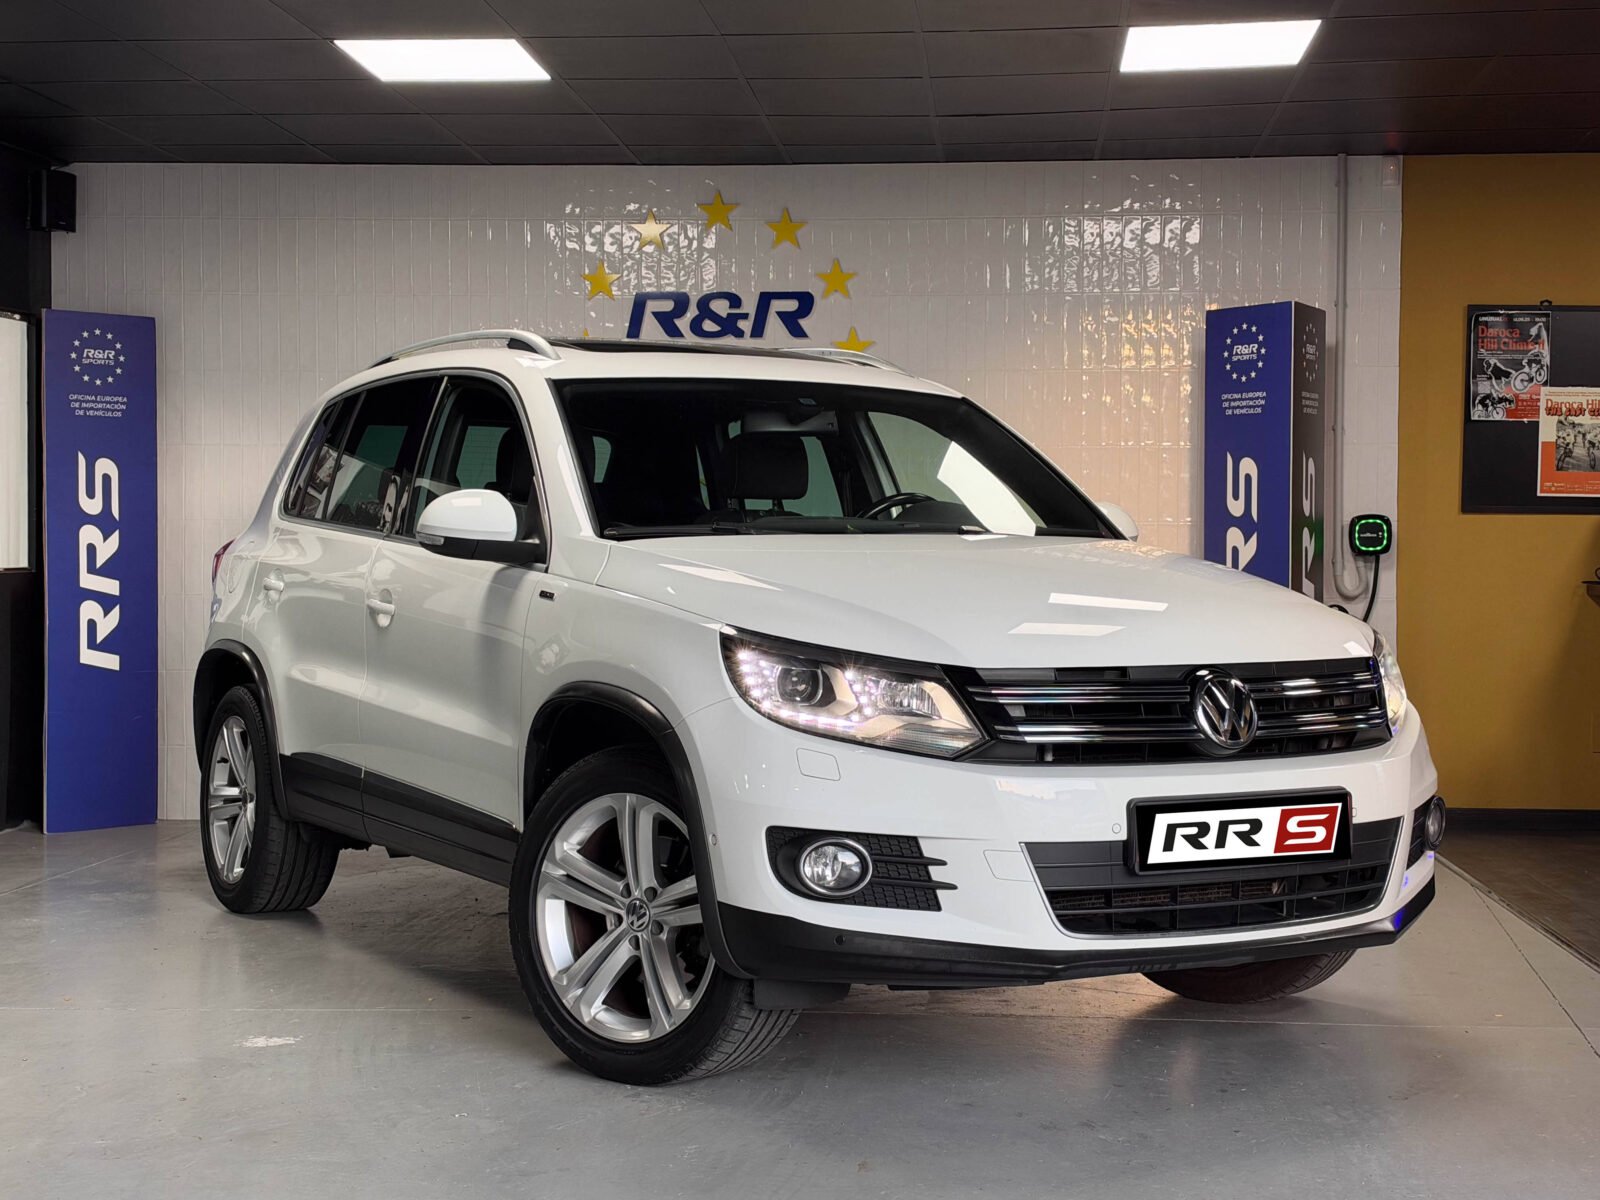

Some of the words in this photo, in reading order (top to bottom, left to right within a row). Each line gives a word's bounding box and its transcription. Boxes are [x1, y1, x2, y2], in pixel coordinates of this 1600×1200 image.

[626, 291, 815, 338] R&R
[1478, 325, 1521, 338] Daroca
[84, 348, 115, 360] R&R
[1233, 344, 1258, 354] R&R
[1242, 391, 1267, 399] EUROPEA
[1230, 399, 1265, 407] IMPORTACIÓN
[1545, 398, 1584, 409] Daroca
[85, 409, 122, 417] VEHÍCULOS
[1233, 407, 1262, 415] VEHÍCULOS
[77, 450, 120, 671] RRS
[1162, 813, 1330, 853] RRS
